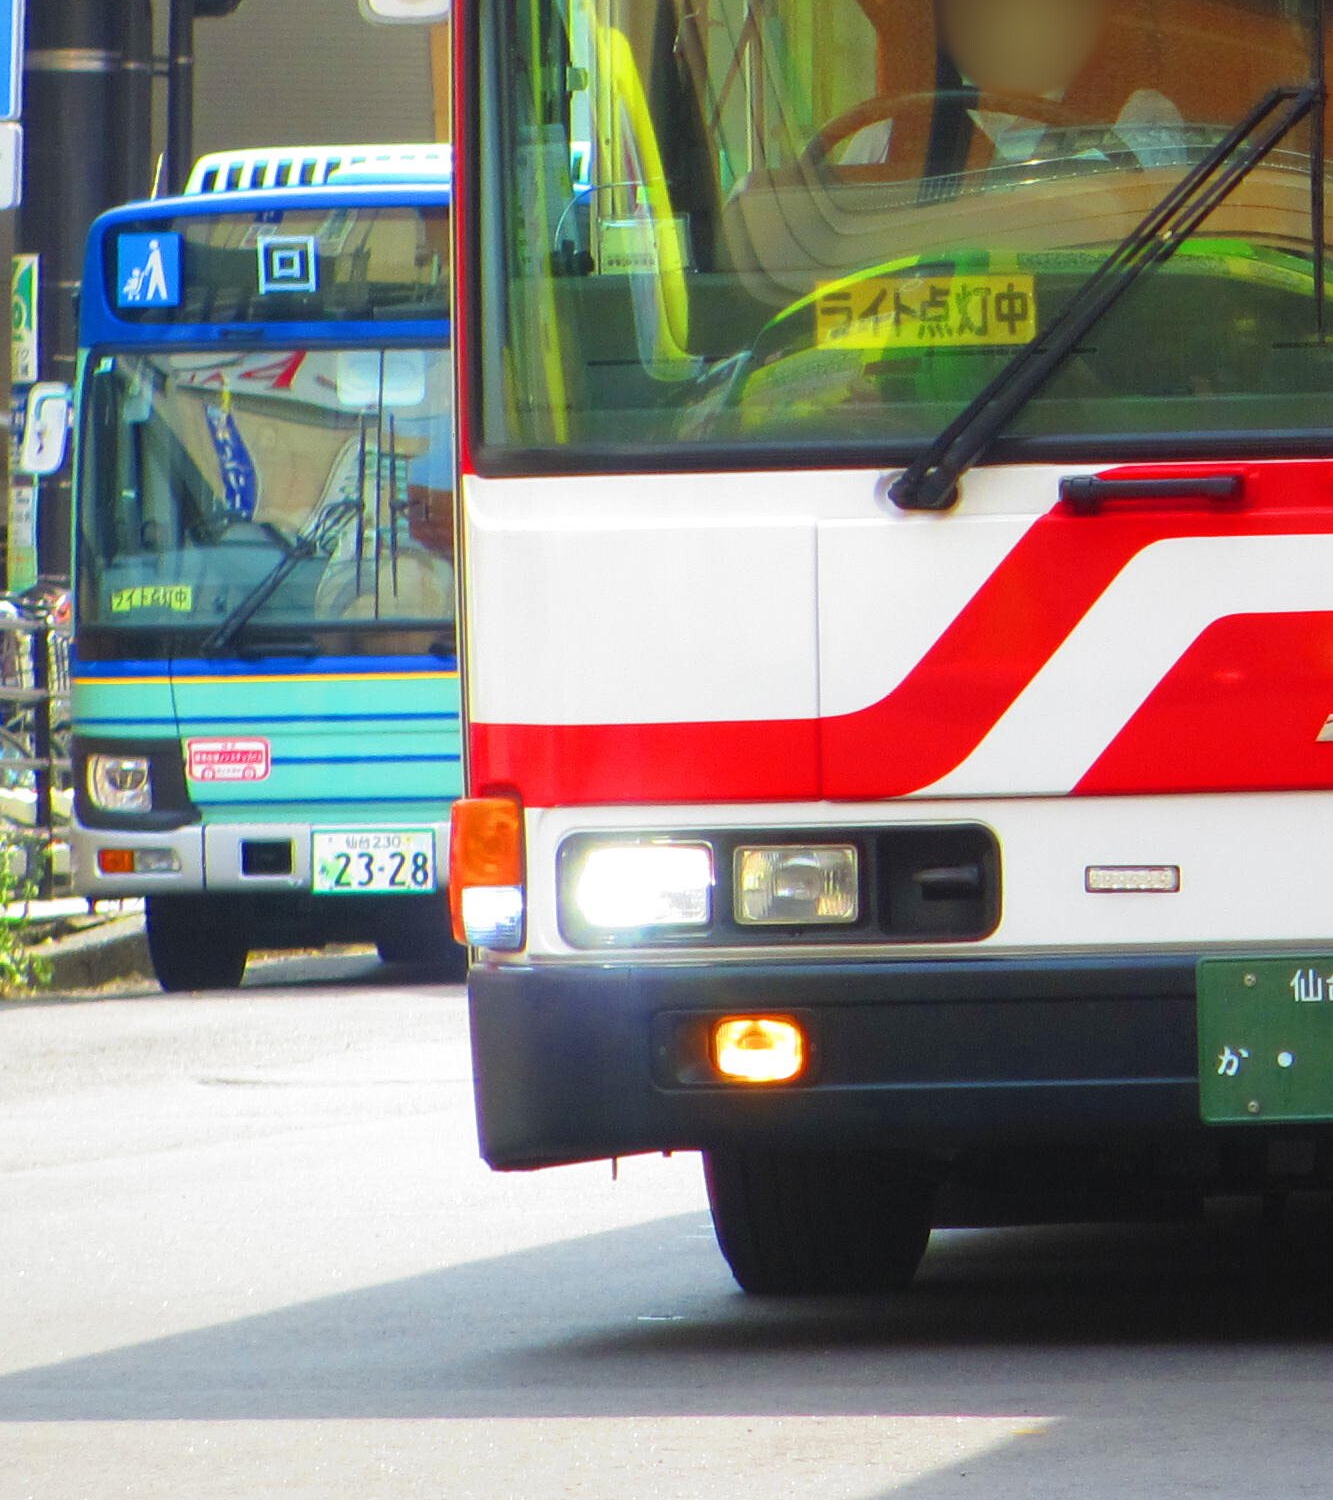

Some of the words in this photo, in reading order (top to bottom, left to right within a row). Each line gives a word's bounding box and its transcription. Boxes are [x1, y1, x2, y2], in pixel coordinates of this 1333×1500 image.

[820, 282, 1030, 340] ライト点灯中
[333, 851, 429, 887] 23-28
[1216, 1046, 1250, 1077] か
